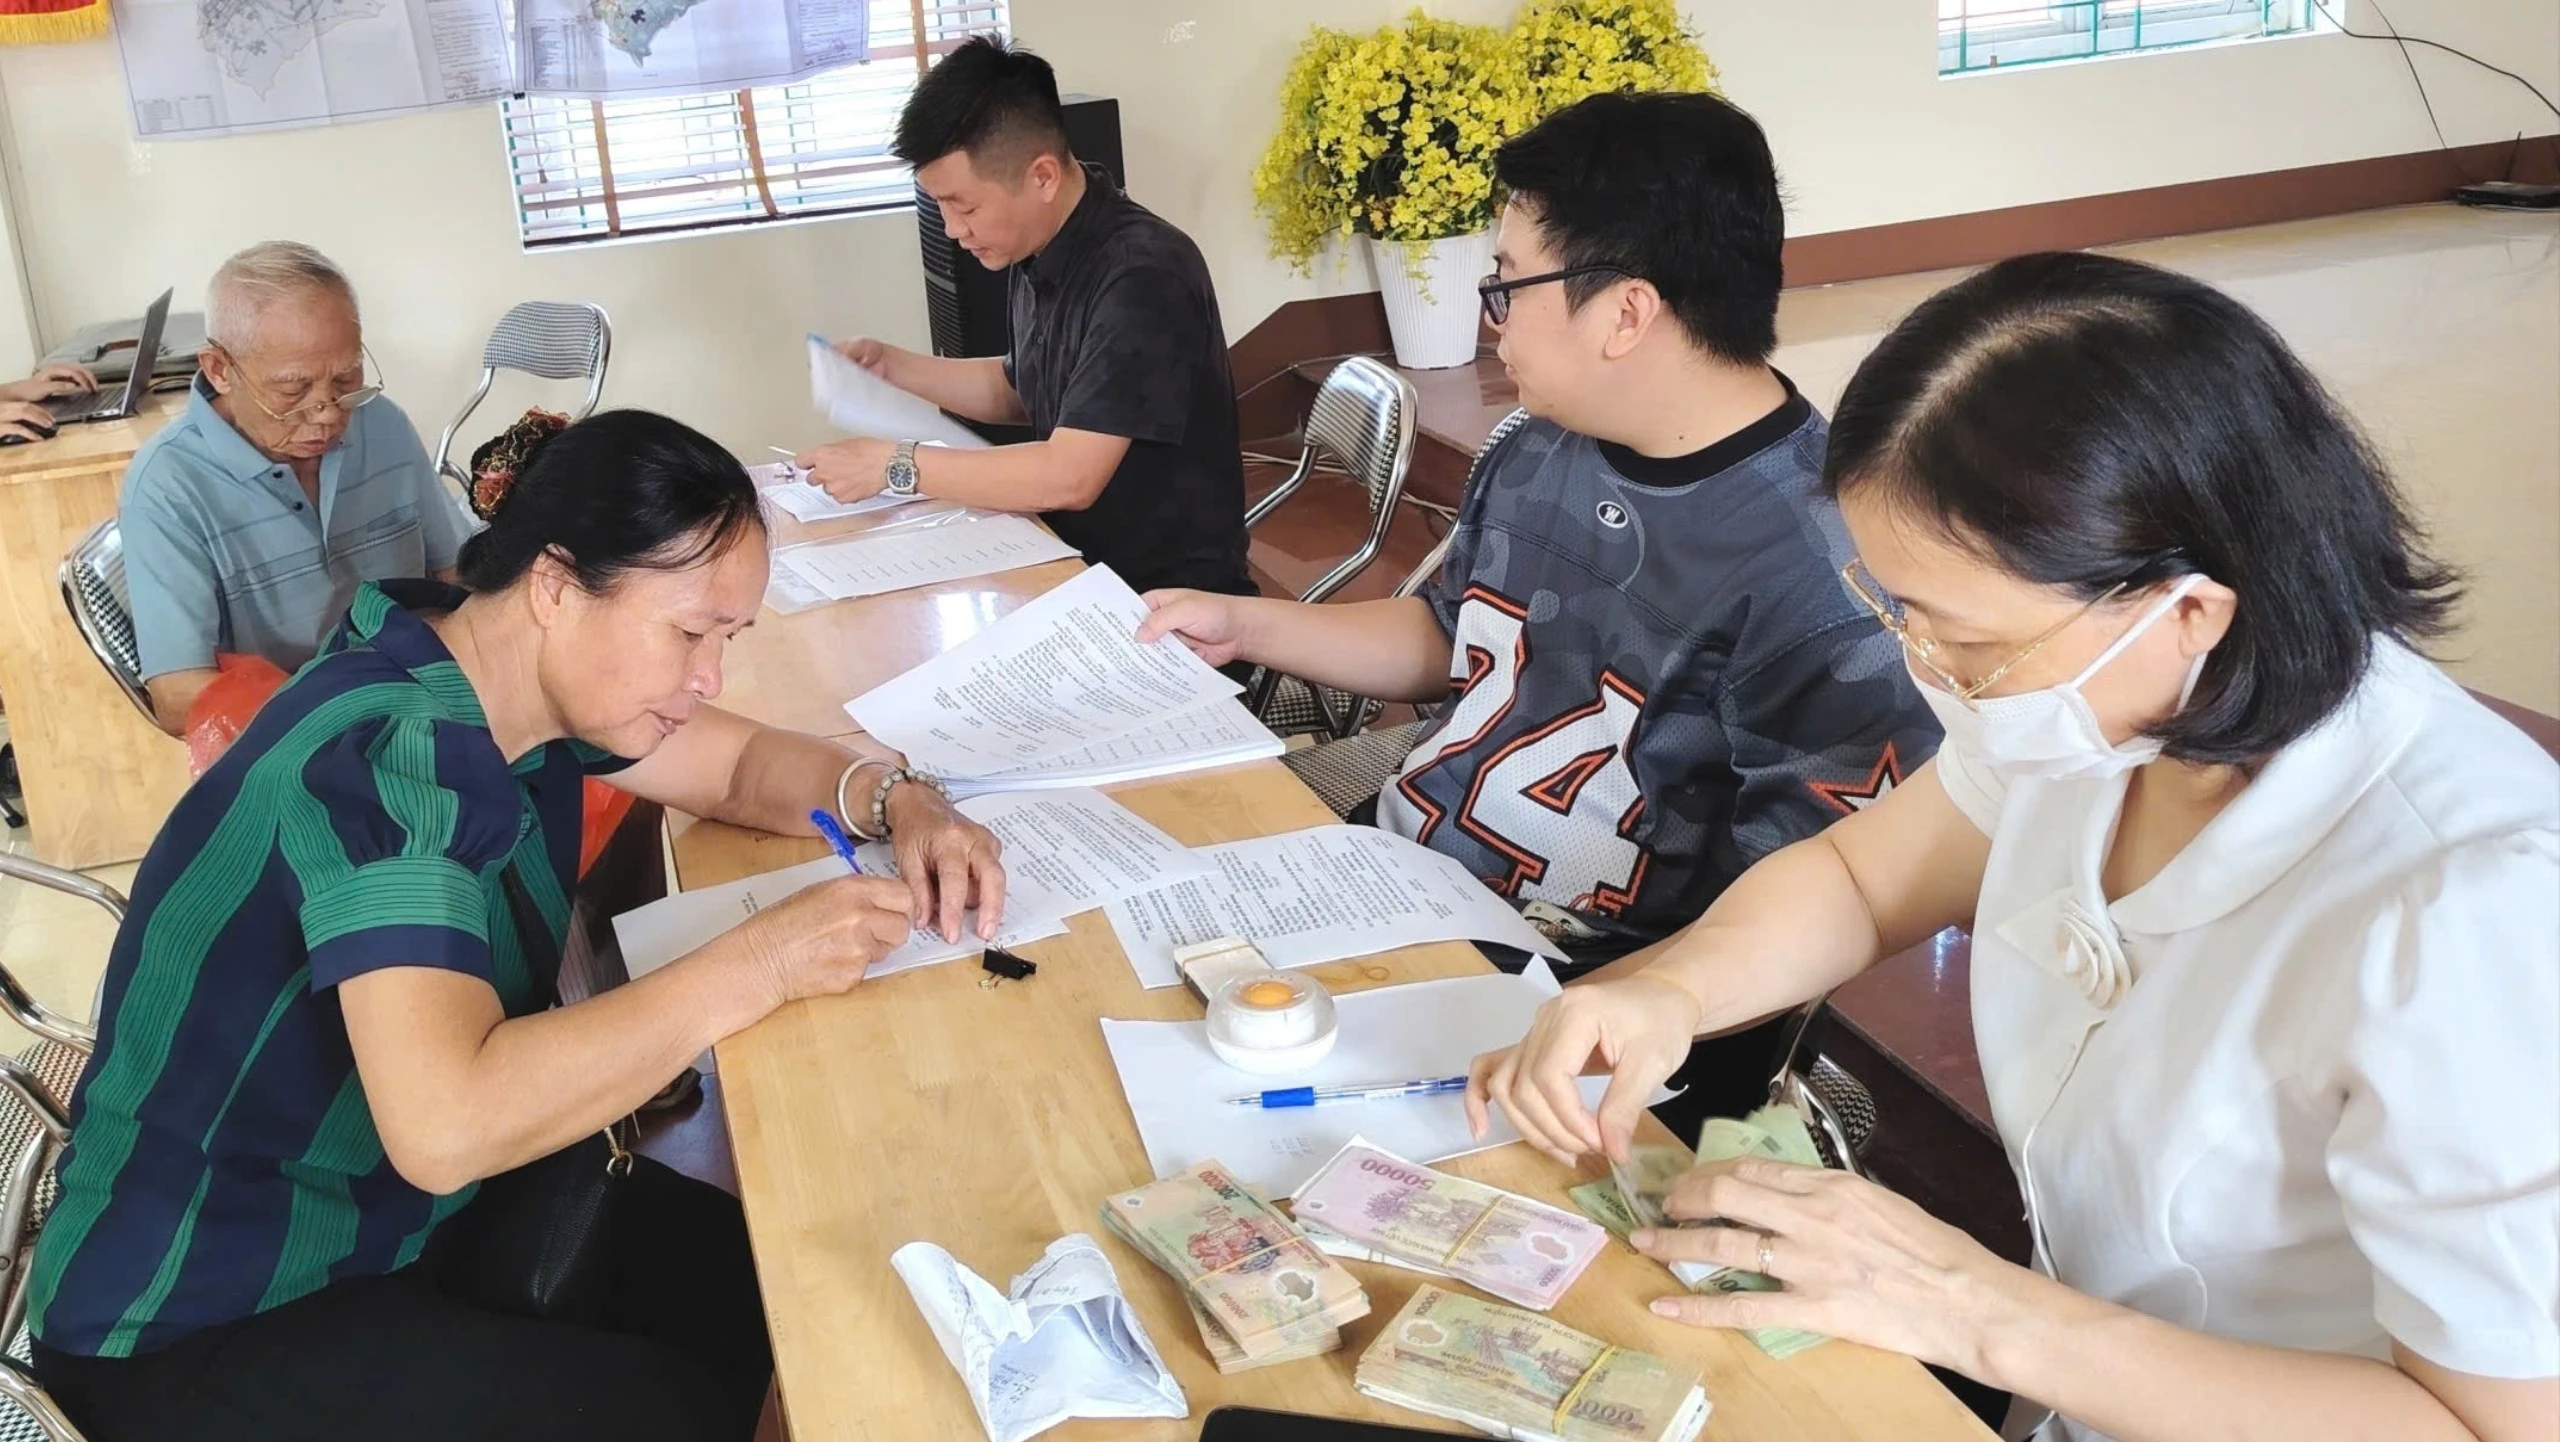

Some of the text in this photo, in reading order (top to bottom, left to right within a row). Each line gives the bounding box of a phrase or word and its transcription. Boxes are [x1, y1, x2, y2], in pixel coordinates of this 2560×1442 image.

[1396, 581, 1652, 917] 24
[1198, 1169, 1240, 1200] 200000
[1359, 1158, 1436, 1191] 50000
[1414, 1291, 1440, 1317] 10000
